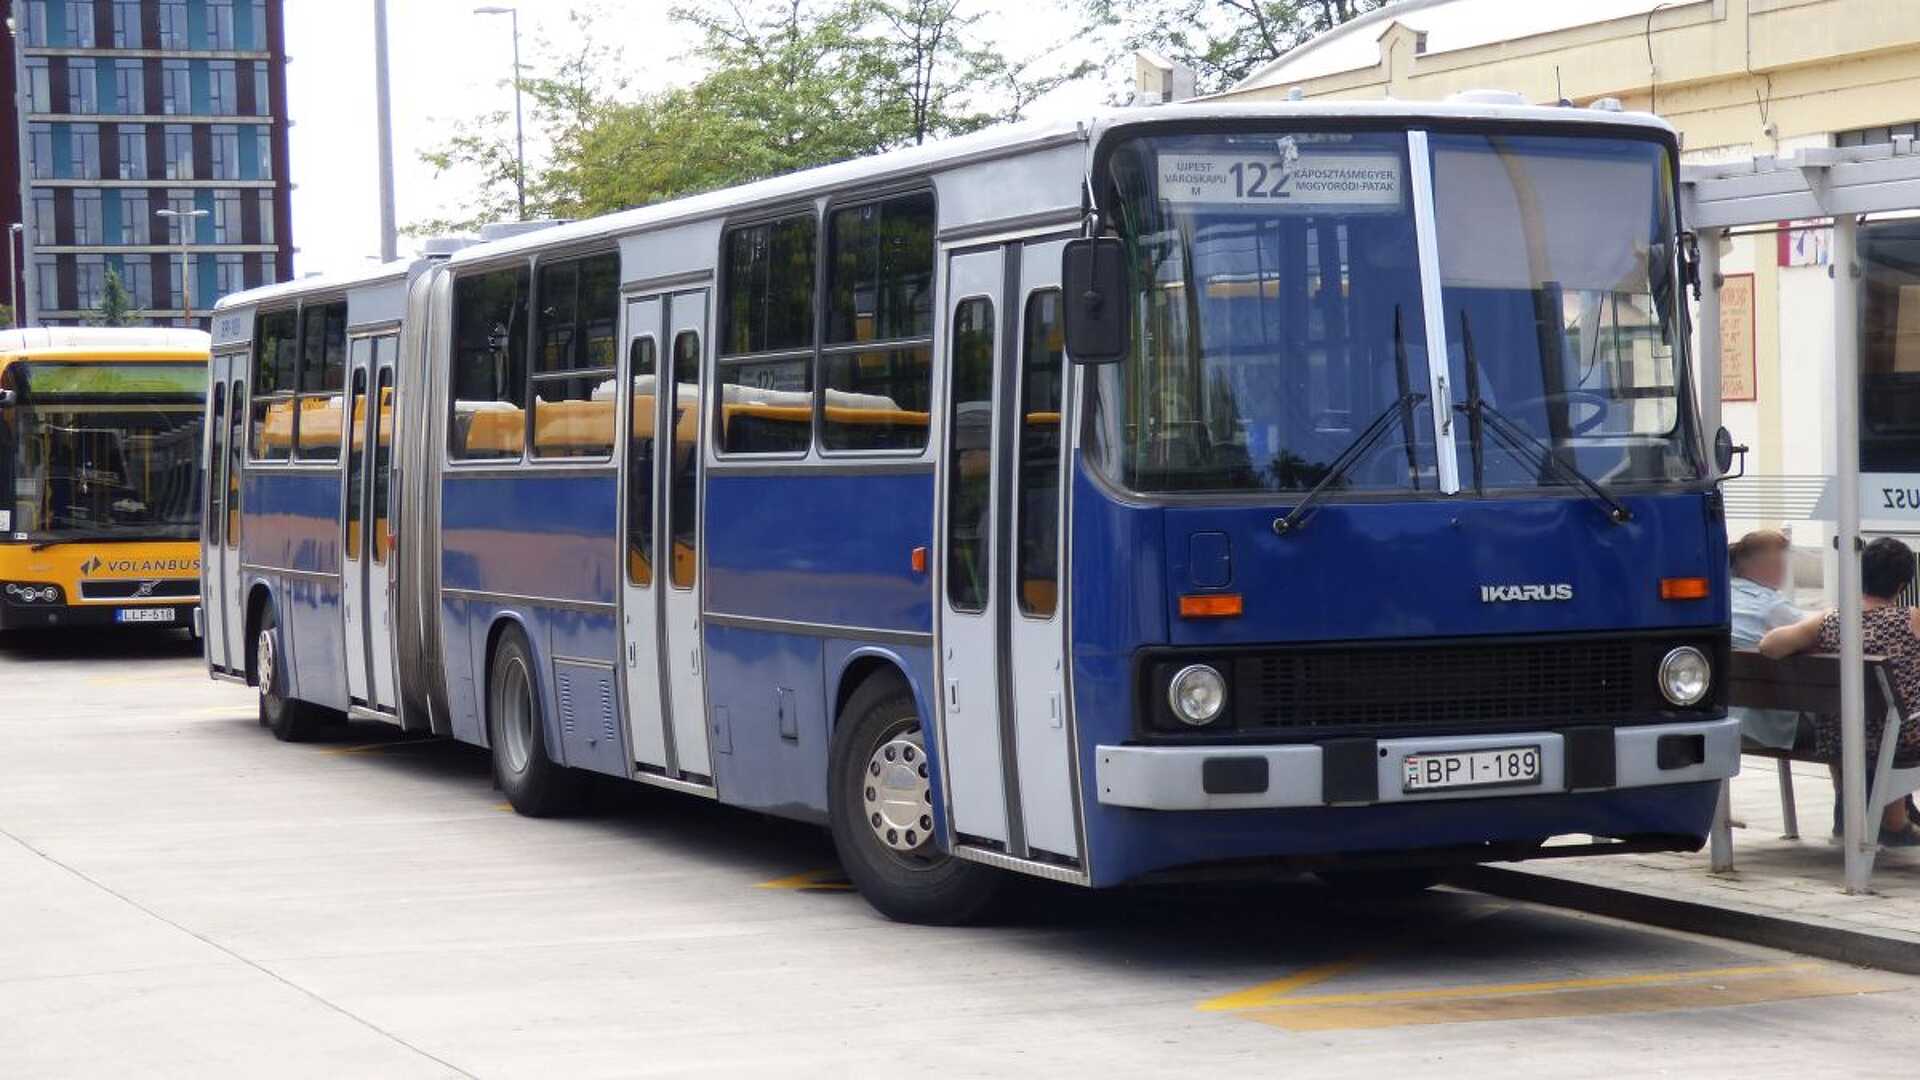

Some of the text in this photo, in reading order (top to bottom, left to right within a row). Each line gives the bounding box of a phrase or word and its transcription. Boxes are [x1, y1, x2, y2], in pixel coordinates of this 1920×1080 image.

[1229, 161, 1291, 198] 122
[1480, 583, 1573, 602] IKARUS
[1426, 751, 1536, 784] BPI-189
